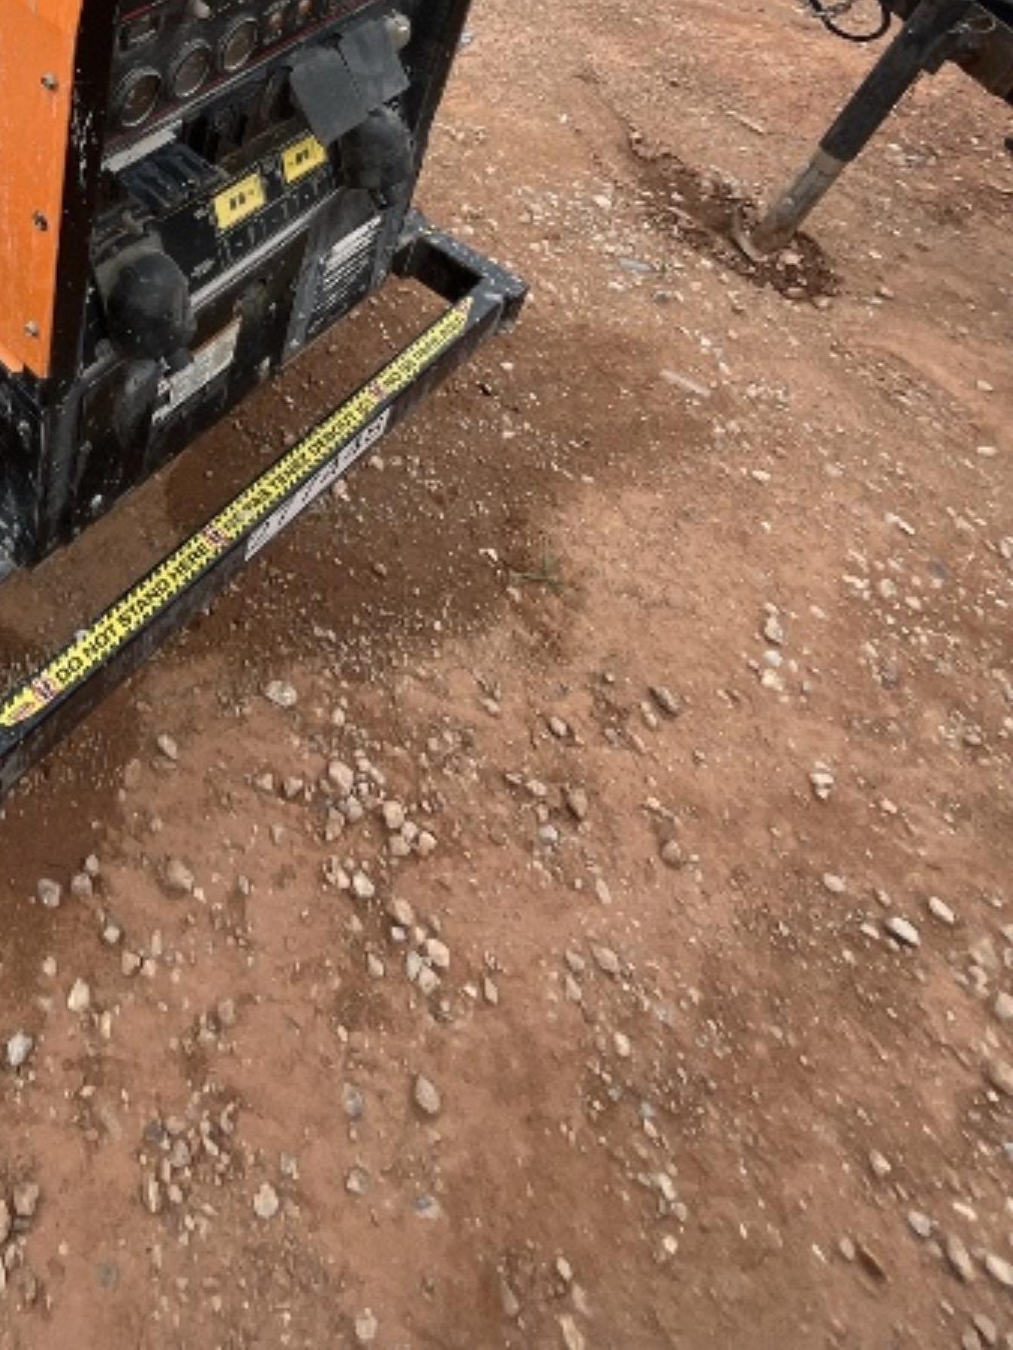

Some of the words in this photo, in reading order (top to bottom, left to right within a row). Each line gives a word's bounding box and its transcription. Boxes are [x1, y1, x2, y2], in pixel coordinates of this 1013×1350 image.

[53, 653, 85, 684] DO
[79, 622, 120, 661] NOT
[116, 576, 173, 629] STAND
[167, 542, 212, 584] HERE
